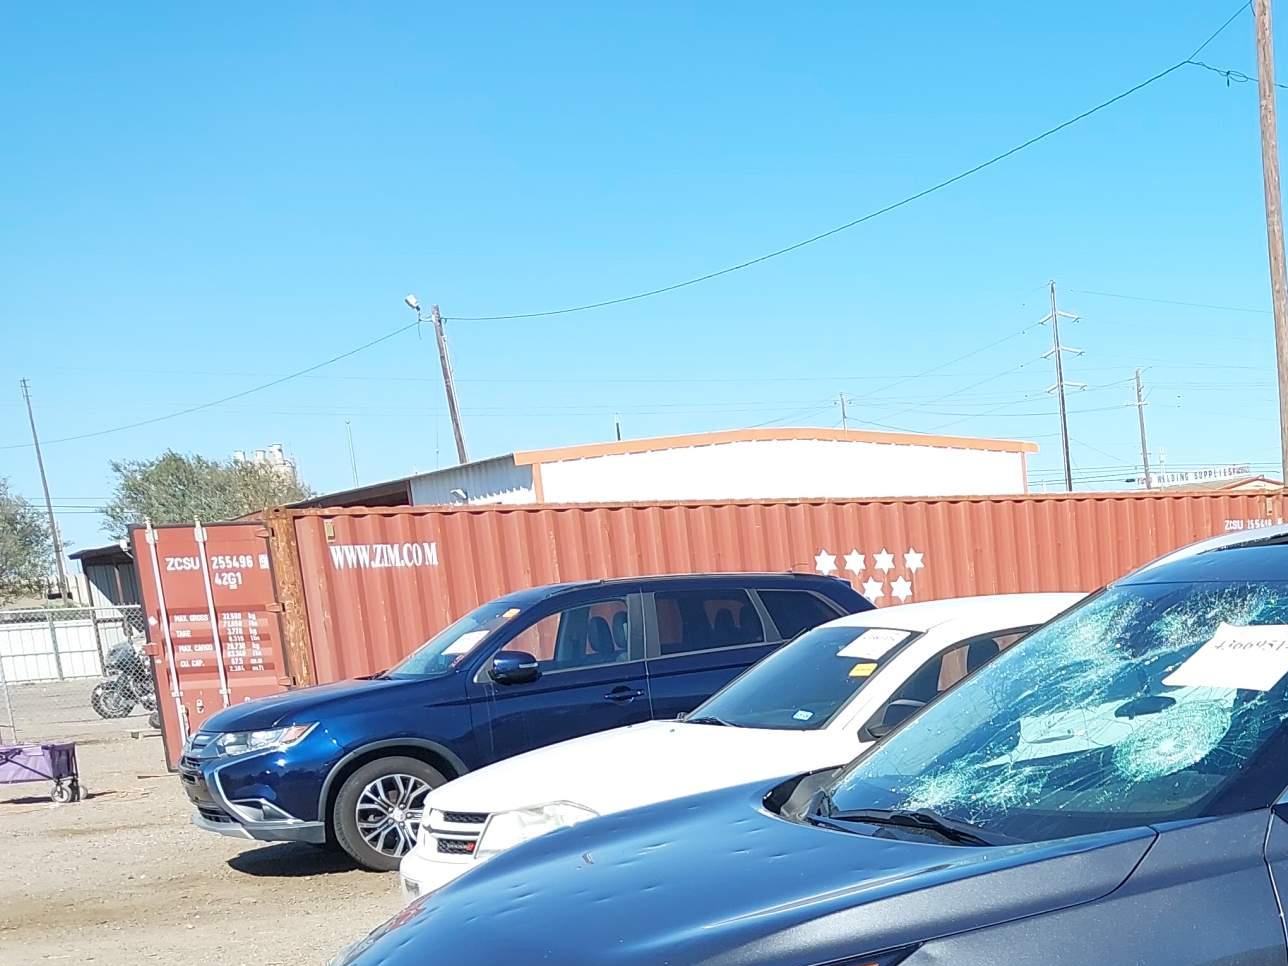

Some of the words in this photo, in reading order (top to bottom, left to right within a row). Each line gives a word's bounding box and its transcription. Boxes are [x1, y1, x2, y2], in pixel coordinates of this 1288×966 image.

[1157, 472, 1189, 484] WELDING
[1193, 466, 1232, 480] SUPPLIES
[165, 556, 200, 571] ZCSU
[211, 554, 254, 570] 255496
[214, 571, 243, 586] 42G1
